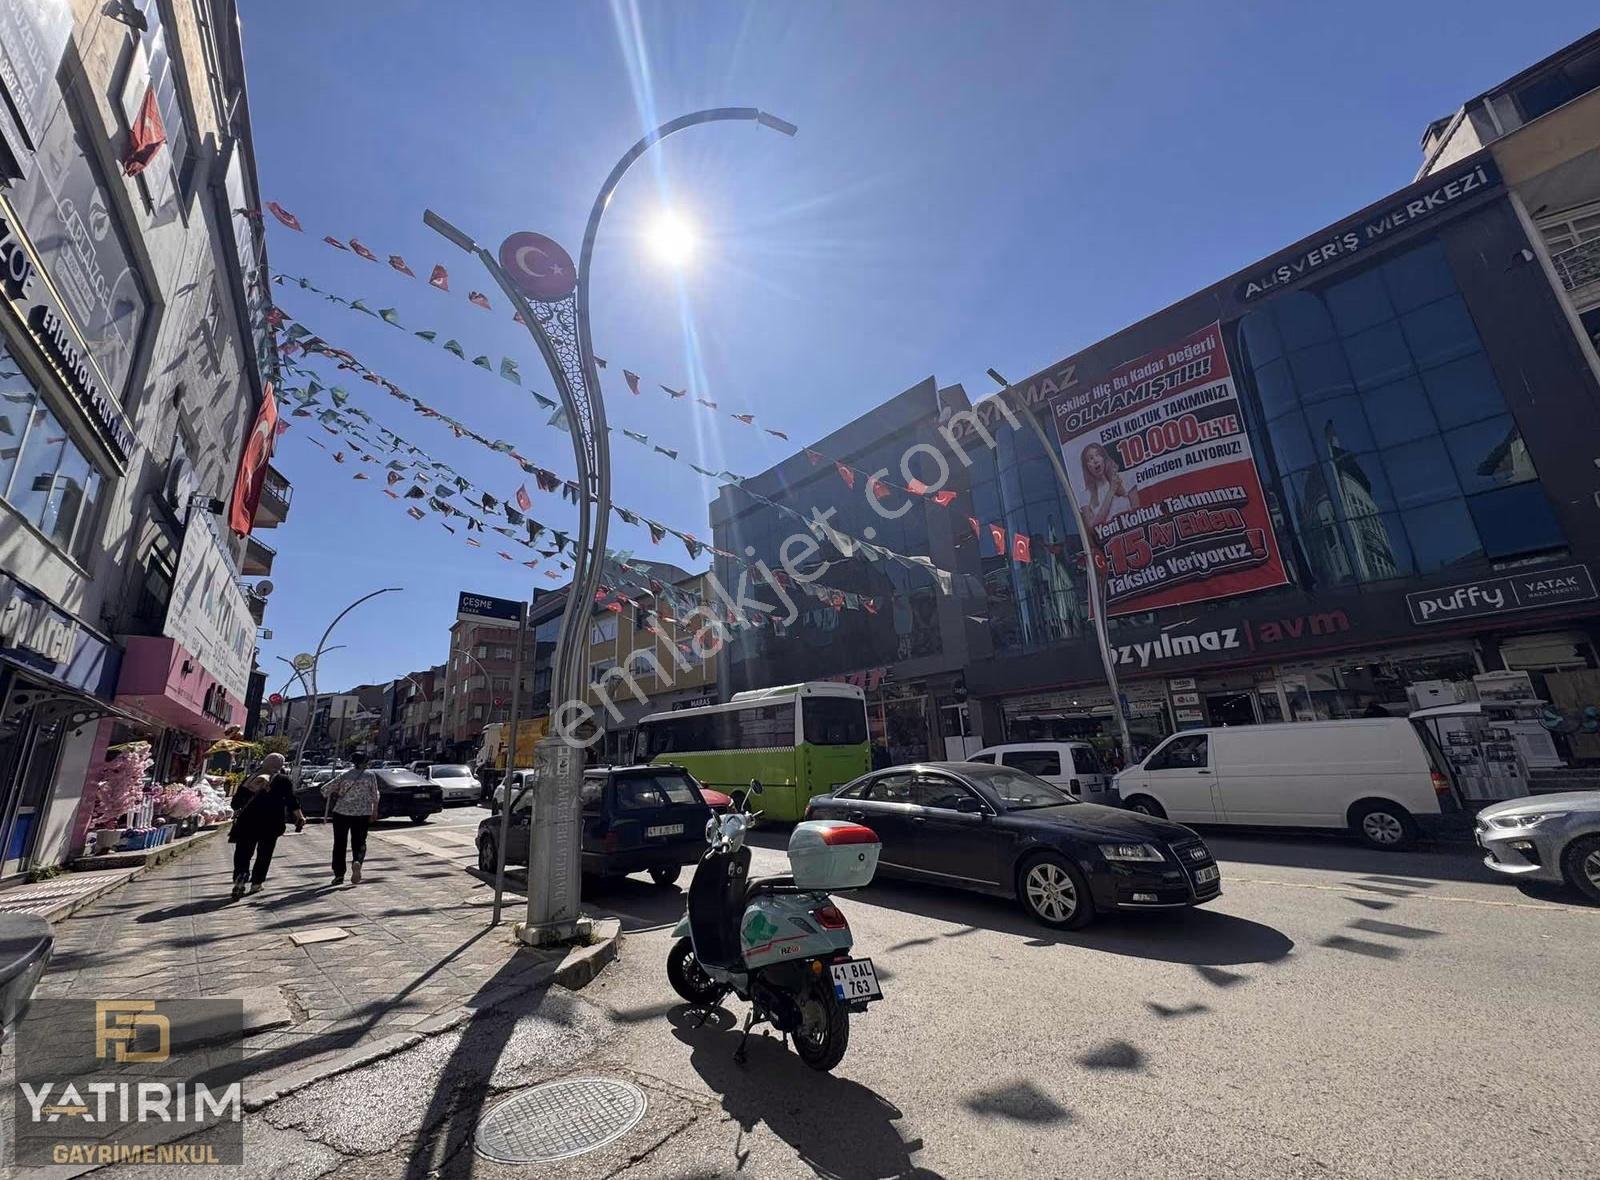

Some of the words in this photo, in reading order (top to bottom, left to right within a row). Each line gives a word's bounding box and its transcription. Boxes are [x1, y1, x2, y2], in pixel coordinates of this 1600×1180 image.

[1245, 231, 1359, 299] ALIŞVERİŞ
[1365, 164, 1488, 239] MERKEZİ
[1056, 391, 1092, 416] Eskiler
[1093, 377, 1111, 399] Hiç
[1113, 374, 1128, 391] Bu
[1129, 359, 1164, 382] Kadar
[1167, 334, 1216, 366] Değerli
[1100, 424, 1123, 443] ESKİ
[1125, 409, 1162, 436] KOLTUK
[1162, 383, 1229, 419] TAKIMINIZI
[1135, 457, 1184, 485] Evinizden
[1185, 441, 1243, 465] ALIYORUZ!
[1095, 519, 1121, 539] Yeni
[1121, 504, 1163, 531] Koltuk
[1164, 485, 1247, 510] Takımınızı
[1105, 530, 1154, 577] 15
[1150, 522, 1178, 550] Ay
[1177, 508, 1246, 539] Elden
[1108, 564, 1166, 597] Taksitle
[1524, 575, 1578, 592] YATAK
[1418, 586, 1505, 620] puffy
[1260, 608, 1350, 644] avm
[834, 967, 847, 981] 41
[851, 962, 873, 978] BAL
[849, 980, 871, 995] 763
